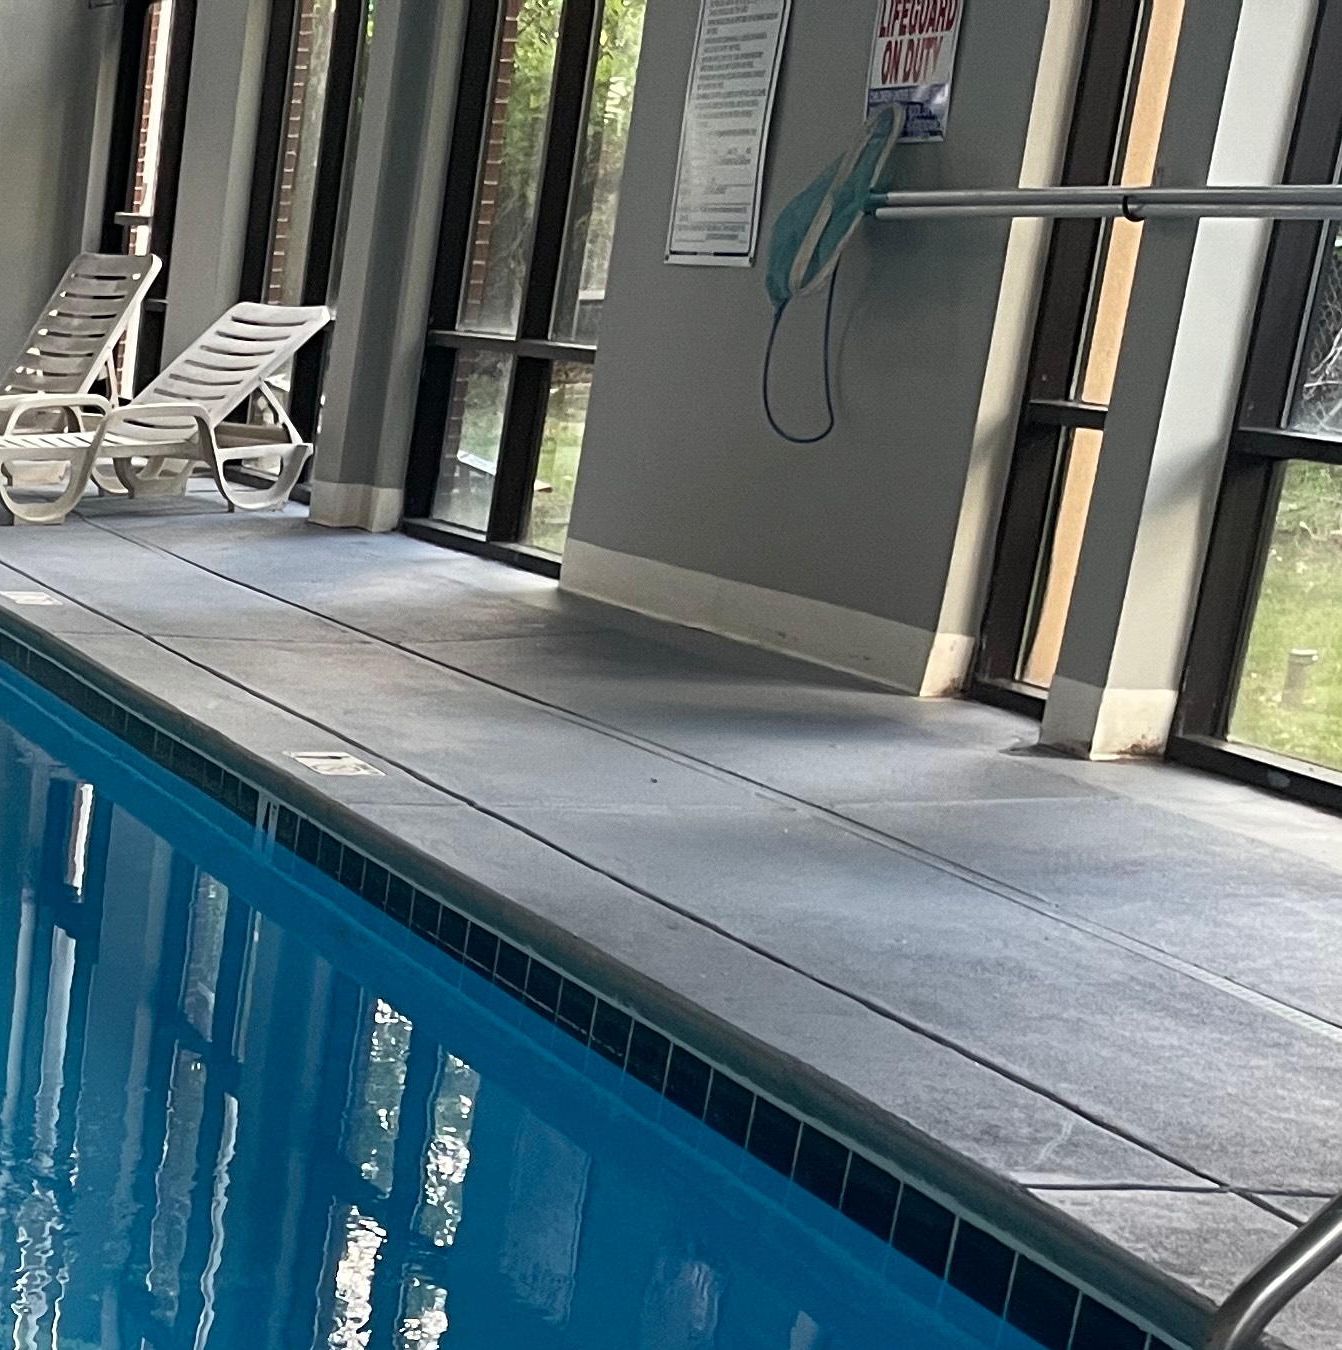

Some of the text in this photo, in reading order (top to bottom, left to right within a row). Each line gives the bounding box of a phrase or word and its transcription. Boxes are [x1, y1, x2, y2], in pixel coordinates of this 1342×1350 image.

[879, 0, 957, 38] LIFEGUARD
[882, 36, 944, 85] ON DUTY
